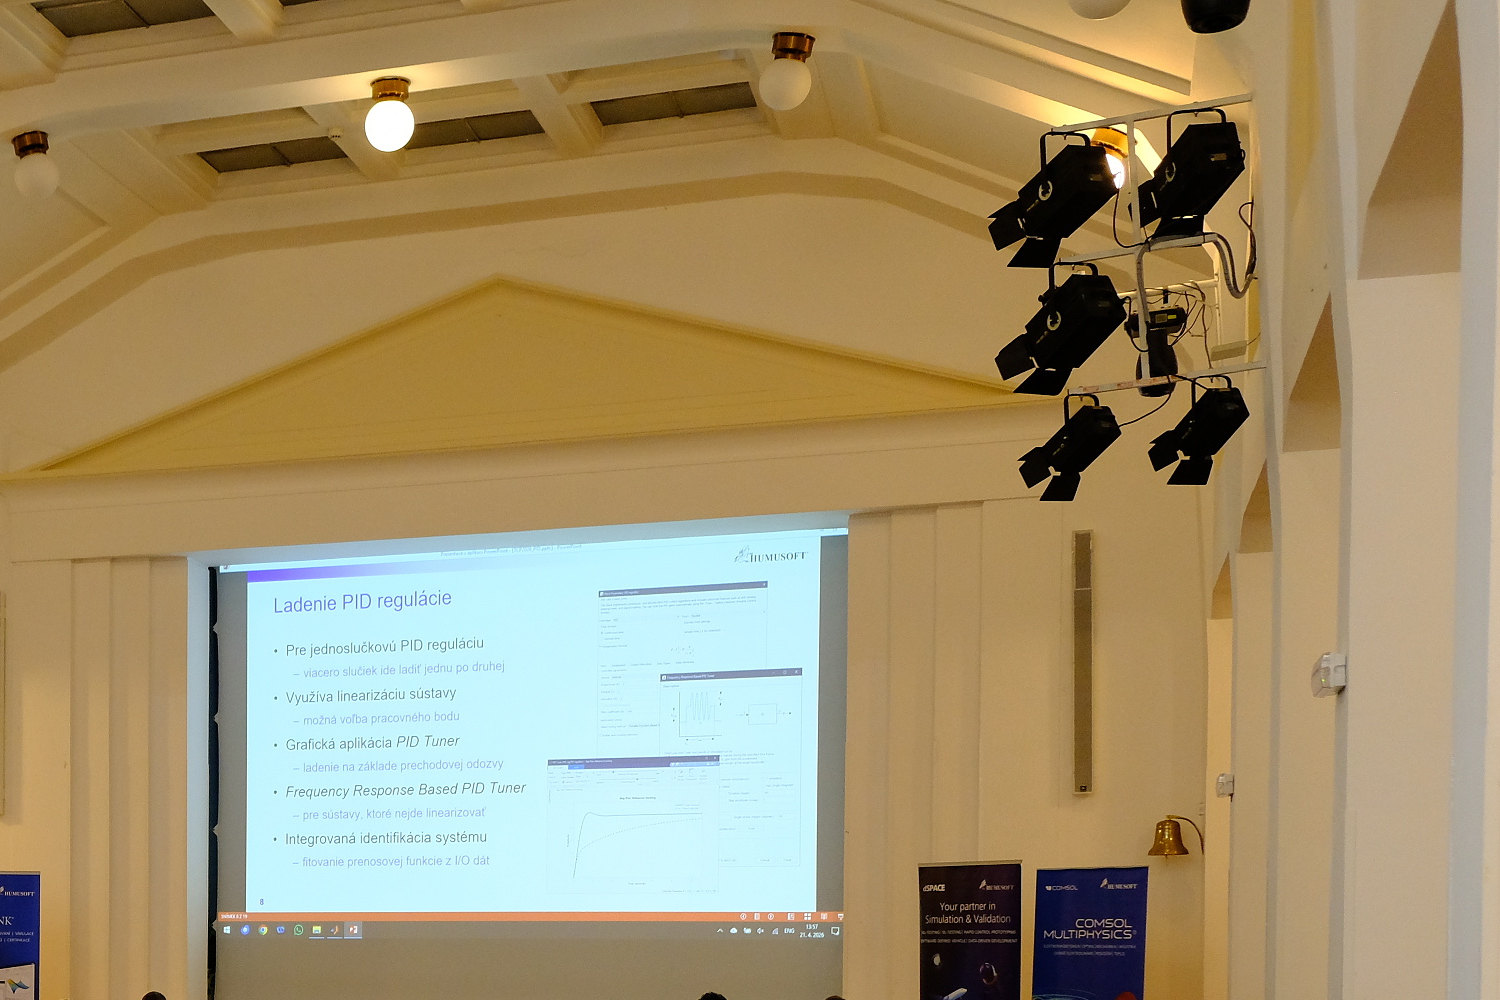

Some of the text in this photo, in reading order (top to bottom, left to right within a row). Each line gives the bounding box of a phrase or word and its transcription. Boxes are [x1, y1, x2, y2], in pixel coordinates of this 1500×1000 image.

[750, 552, 806, 563] HUMUSOFT
[274, 590, 452, 613] Ladenie PID regulácie
[286, 637, 484, 658] Pre jednoslučkovú PID reguláciu
[303, 668, 340, 678] viacero
[342, 665, 377, 676] slučiek
[380, 665, 395, 676] ide
[424, 663, 452, 677] jednu
[456, 664, 469, 676] po
[472, 660, 505, 674] druhej
[286, 688, 456, 706] Využíva linearizáciu sústavy
[303, 714, 337, 725] možná
[371, 712, 431, 725] pracovného
[434, 711, 460, 722] bodu
[286, 734, 460, 752] Grafická aplikácia PID Tuner
[303, 759, 504, 774] ladenie na základe prechodovej odozvy
[286, 782, 526, 800] Frequency Response Based PID Tuner
[302, 812, 319, 822] pre
[366, 808, 392, 819] ktoré
[394, 808, 423, 820] nejde
[286, 830, 487, 848] Integrovaná identifikácia systému
[302, 854, 490, 869] fitovanie prenosovej funkcie z I/O dát
[940, 902, 996, 913] Your partner in
[925, 914, 1011, 924] Simulation & Validation
[1076, 919, 1132, 928] COMSOL
